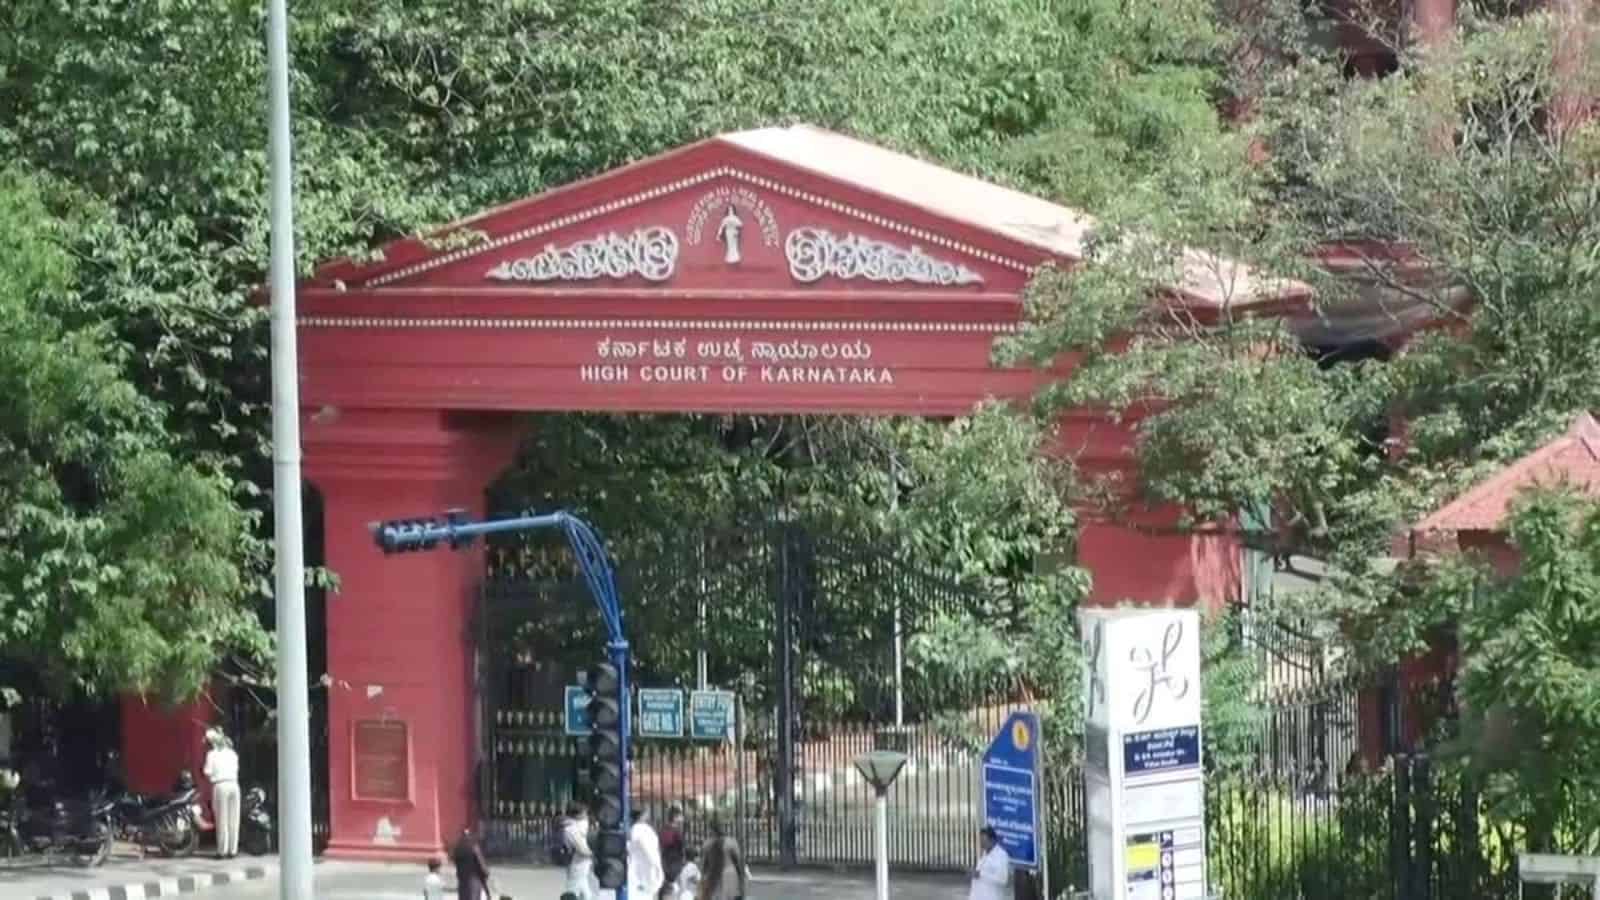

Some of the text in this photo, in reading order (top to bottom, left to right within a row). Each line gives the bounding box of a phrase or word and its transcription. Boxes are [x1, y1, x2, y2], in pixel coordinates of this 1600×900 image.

[597, 338, 687, 359] ಕರ್ನಾಟಕ
[751, 339, 872, 363] ನ್ಯಾಯಾಲಯ
[581, 366, 894, 384] HIGH COURT OF KARNATAKA
